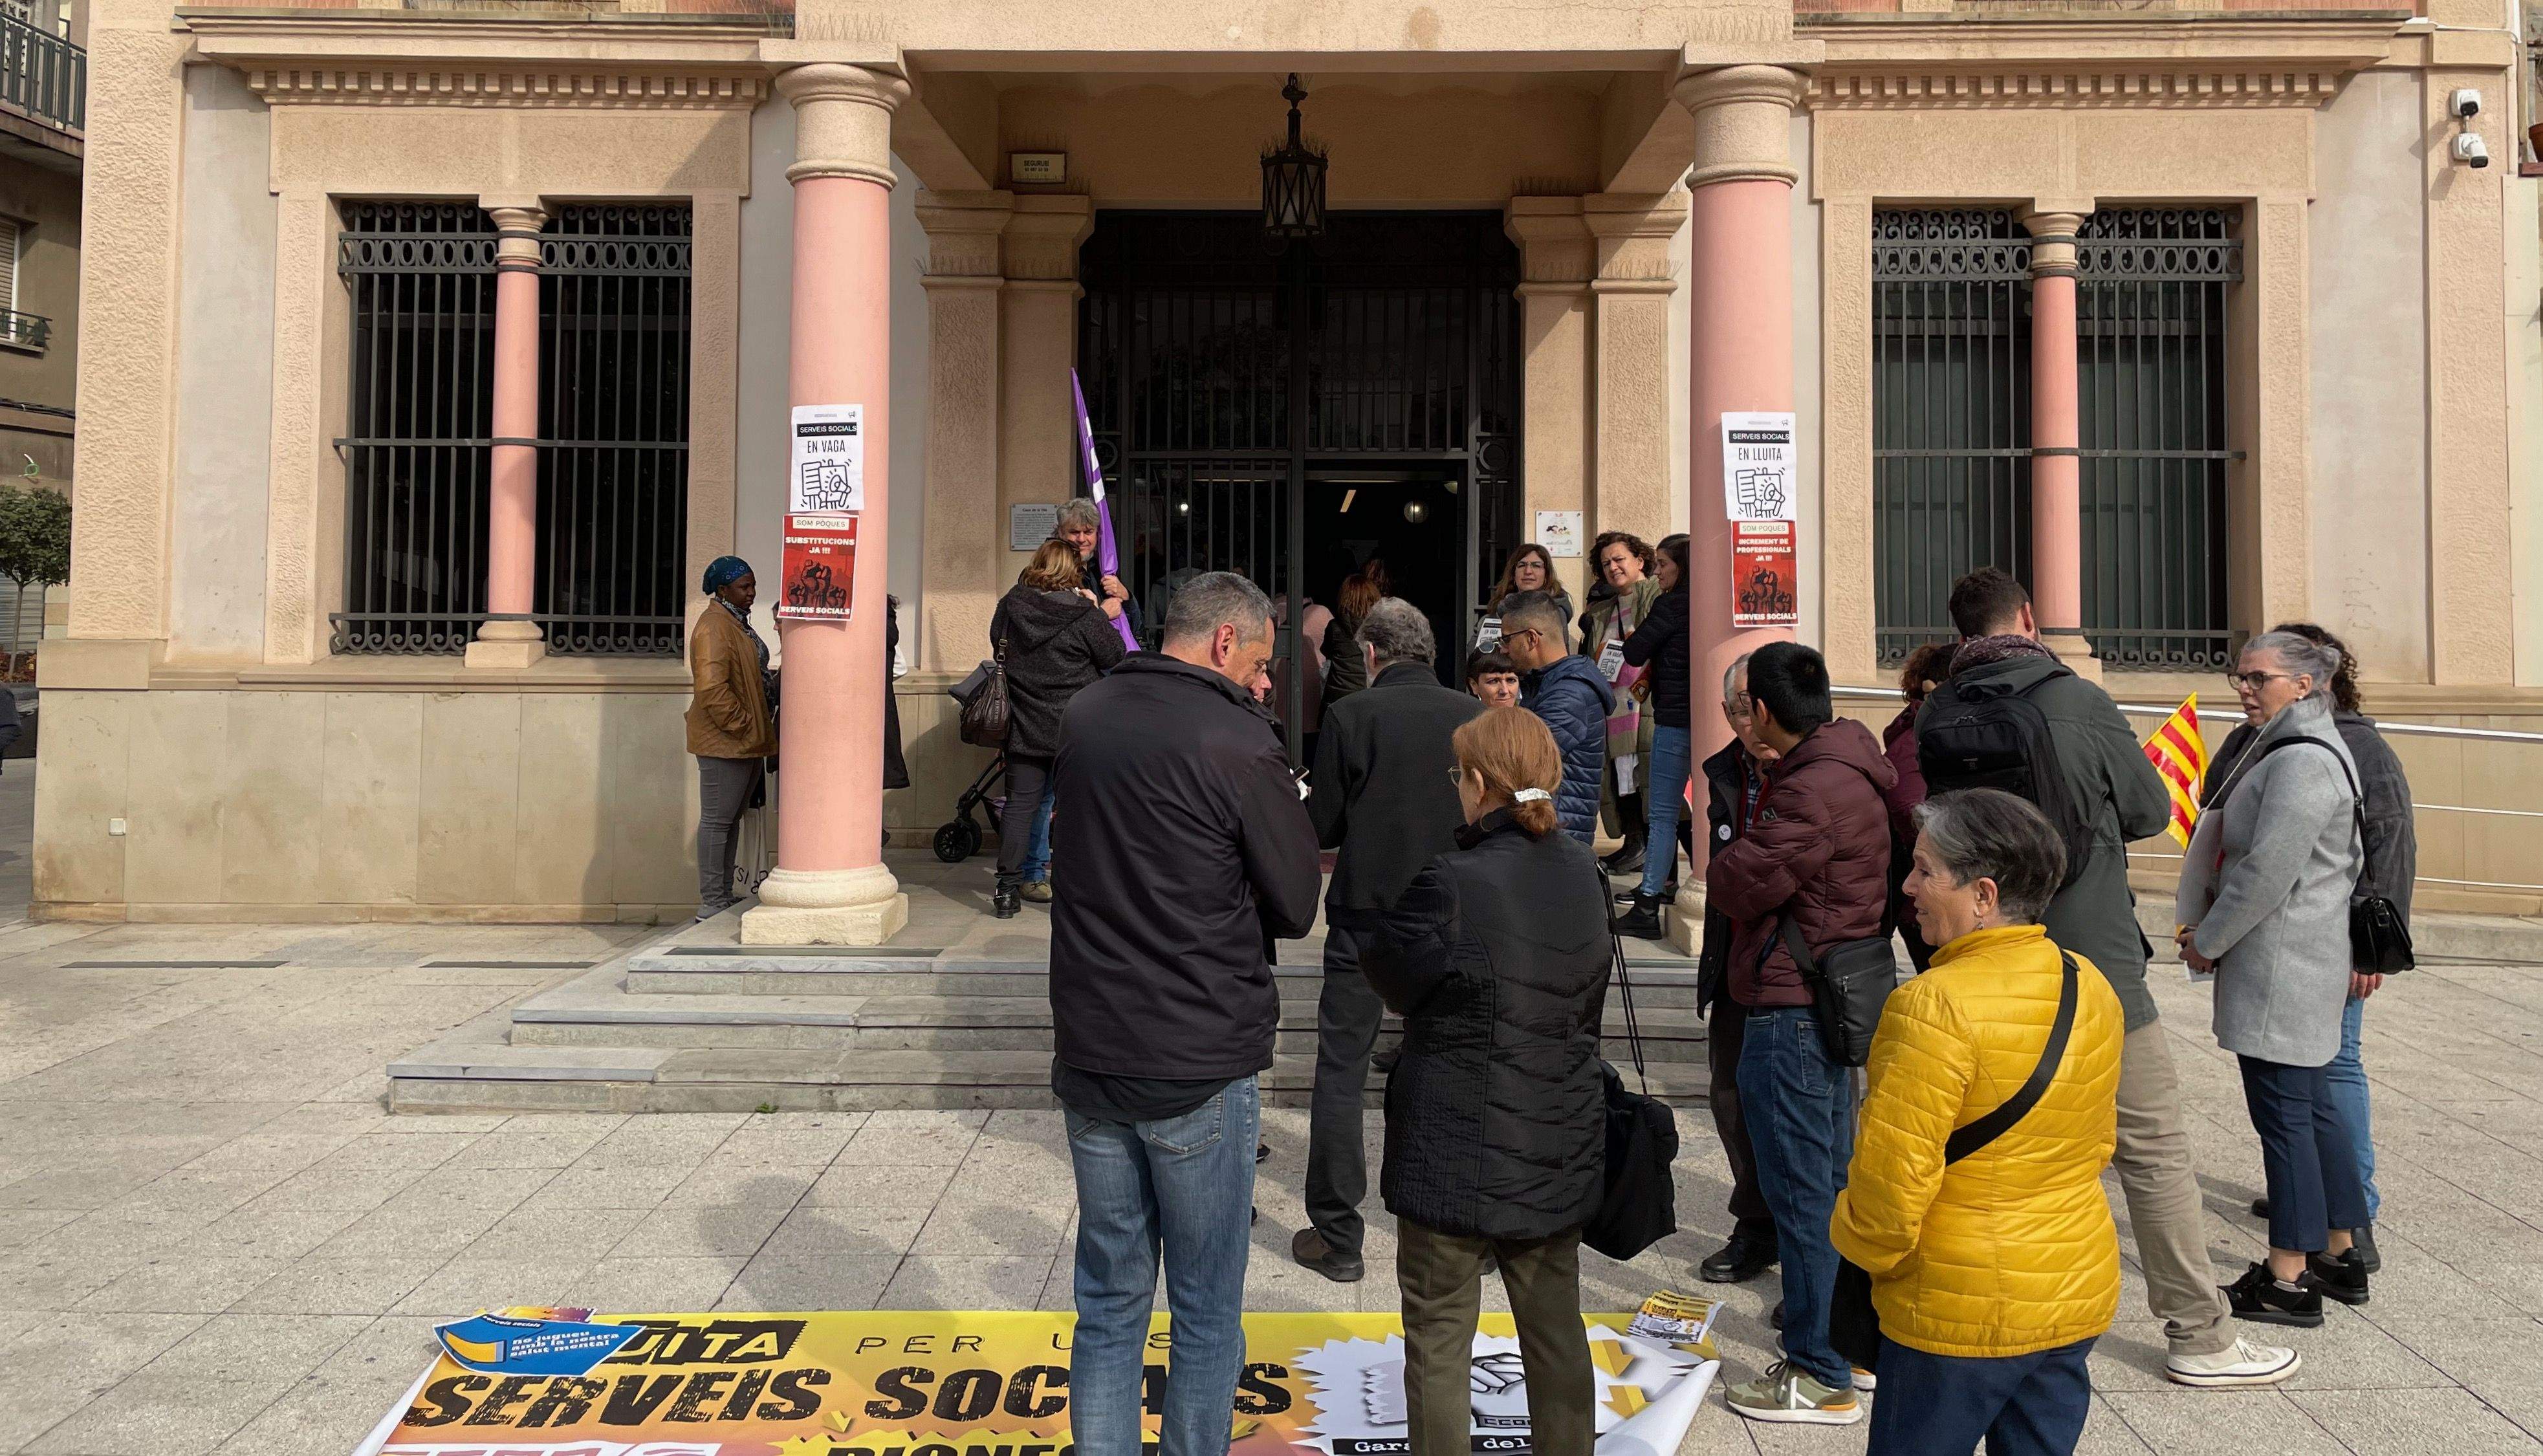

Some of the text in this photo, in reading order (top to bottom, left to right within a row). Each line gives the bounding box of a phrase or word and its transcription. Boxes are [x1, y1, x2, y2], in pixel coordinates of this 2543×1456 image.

[800, 424, 857, 433] SERVEIS SOCIALS
[807, 439, 846, 453] EN VAGA
[1738, 447, 1782, 461] EN LLUITA
[816, 520, 846, 528] POQUES
[785, 536, 855, 546] SUBSTITUCIONS
[780, 605, 851, 615] SERVEIS SOCIALS
[1735, 613, 1797, 621] SERVEIS SOCIALS
[511, 1342, 546, 1351] amb
[569, 1333, 619, 1344] nostra
[534, 1331, 589, 1343] jugueu
[510, 1339, 609, 1358] salut mental
[855, 1334, 986, 1356] PER
[400, 1362, 1292, 1429] SERVEIS SOCAS
